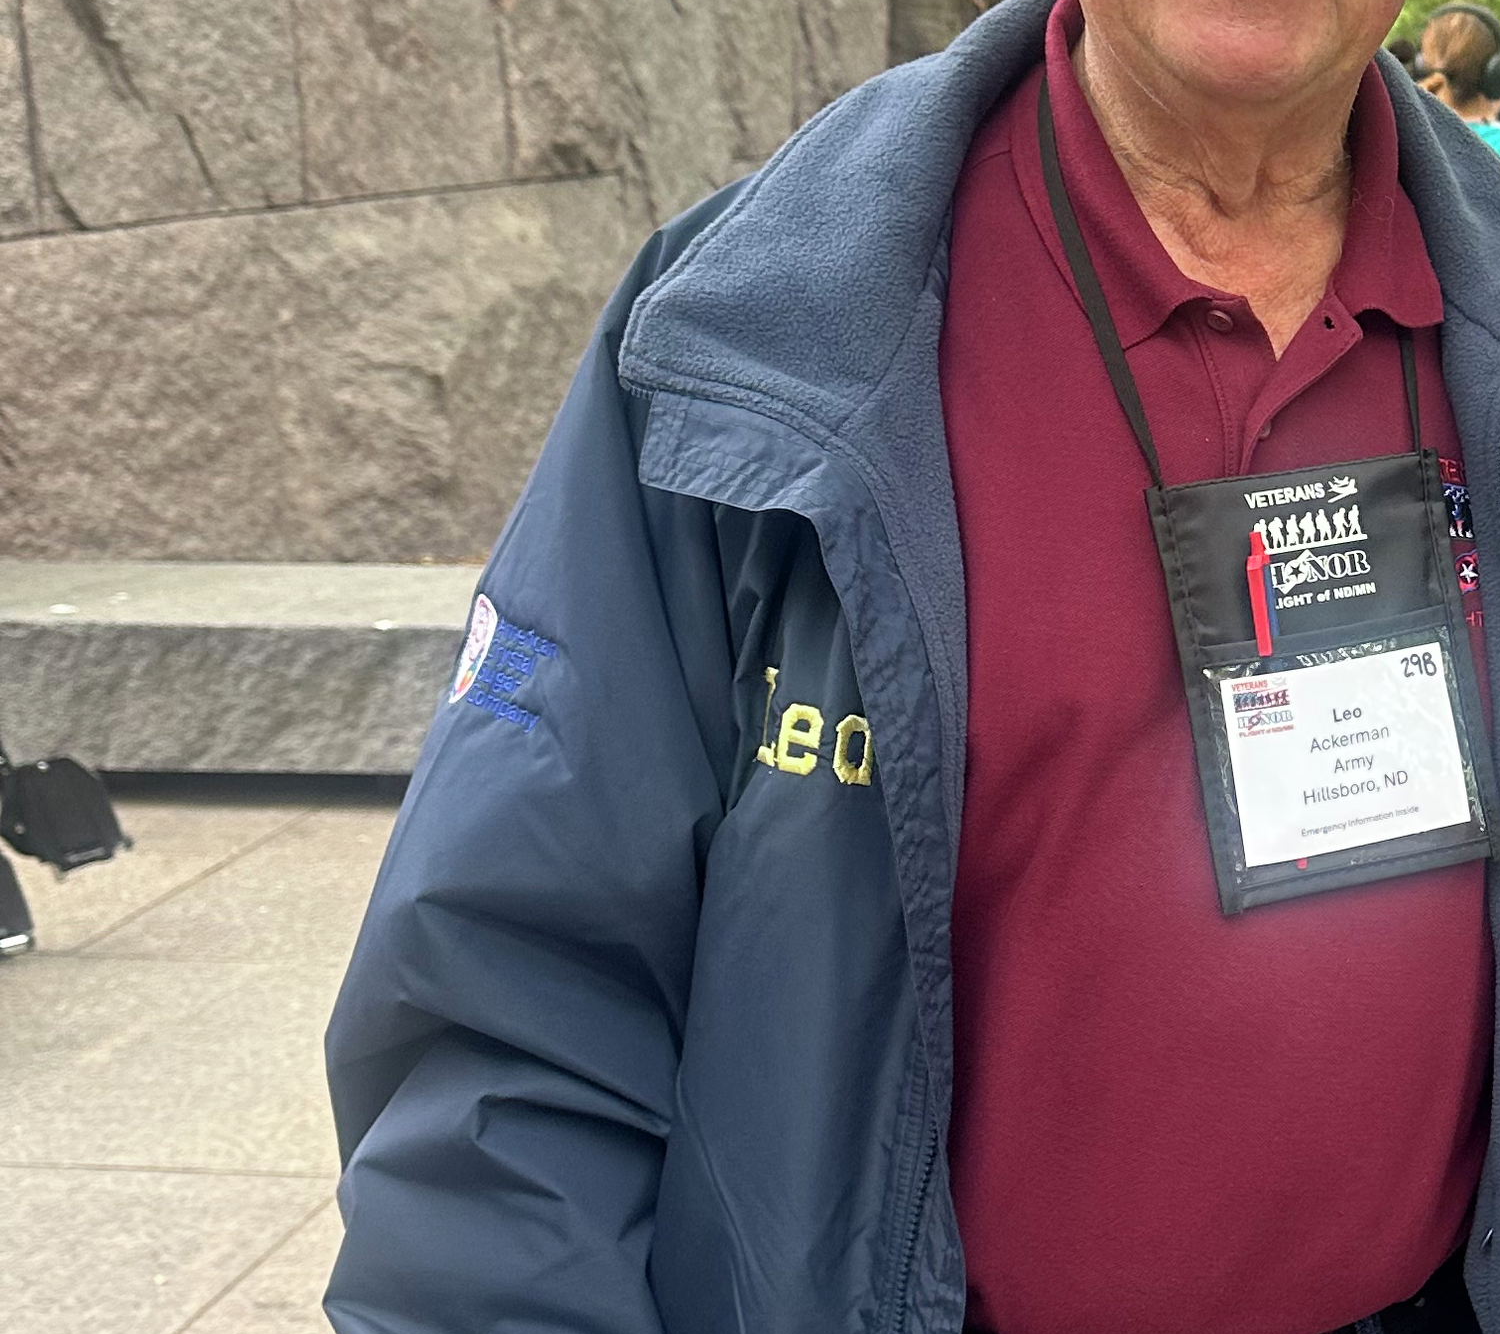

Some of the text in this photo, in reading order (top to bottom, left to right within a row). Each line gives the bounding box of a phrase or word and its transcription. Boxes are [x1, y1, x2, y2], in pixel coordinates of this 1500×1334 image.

[1244, 482, 1326, 509] VETERANS
[1276, 582, 1377, 610] IGHT of ND/MN
[1400, 651, 1438, 678] 29B
[466, 683, 540, 734] Company
[1332, 707, 1362, 723] Leo
[1310, 726, 1390, 753] Ackerman
[1333, 754, 1375, 774] Army
[1303, 770, 1409, 805] Hillsboro, ND
[1347, 812, 1394, 827] Information
